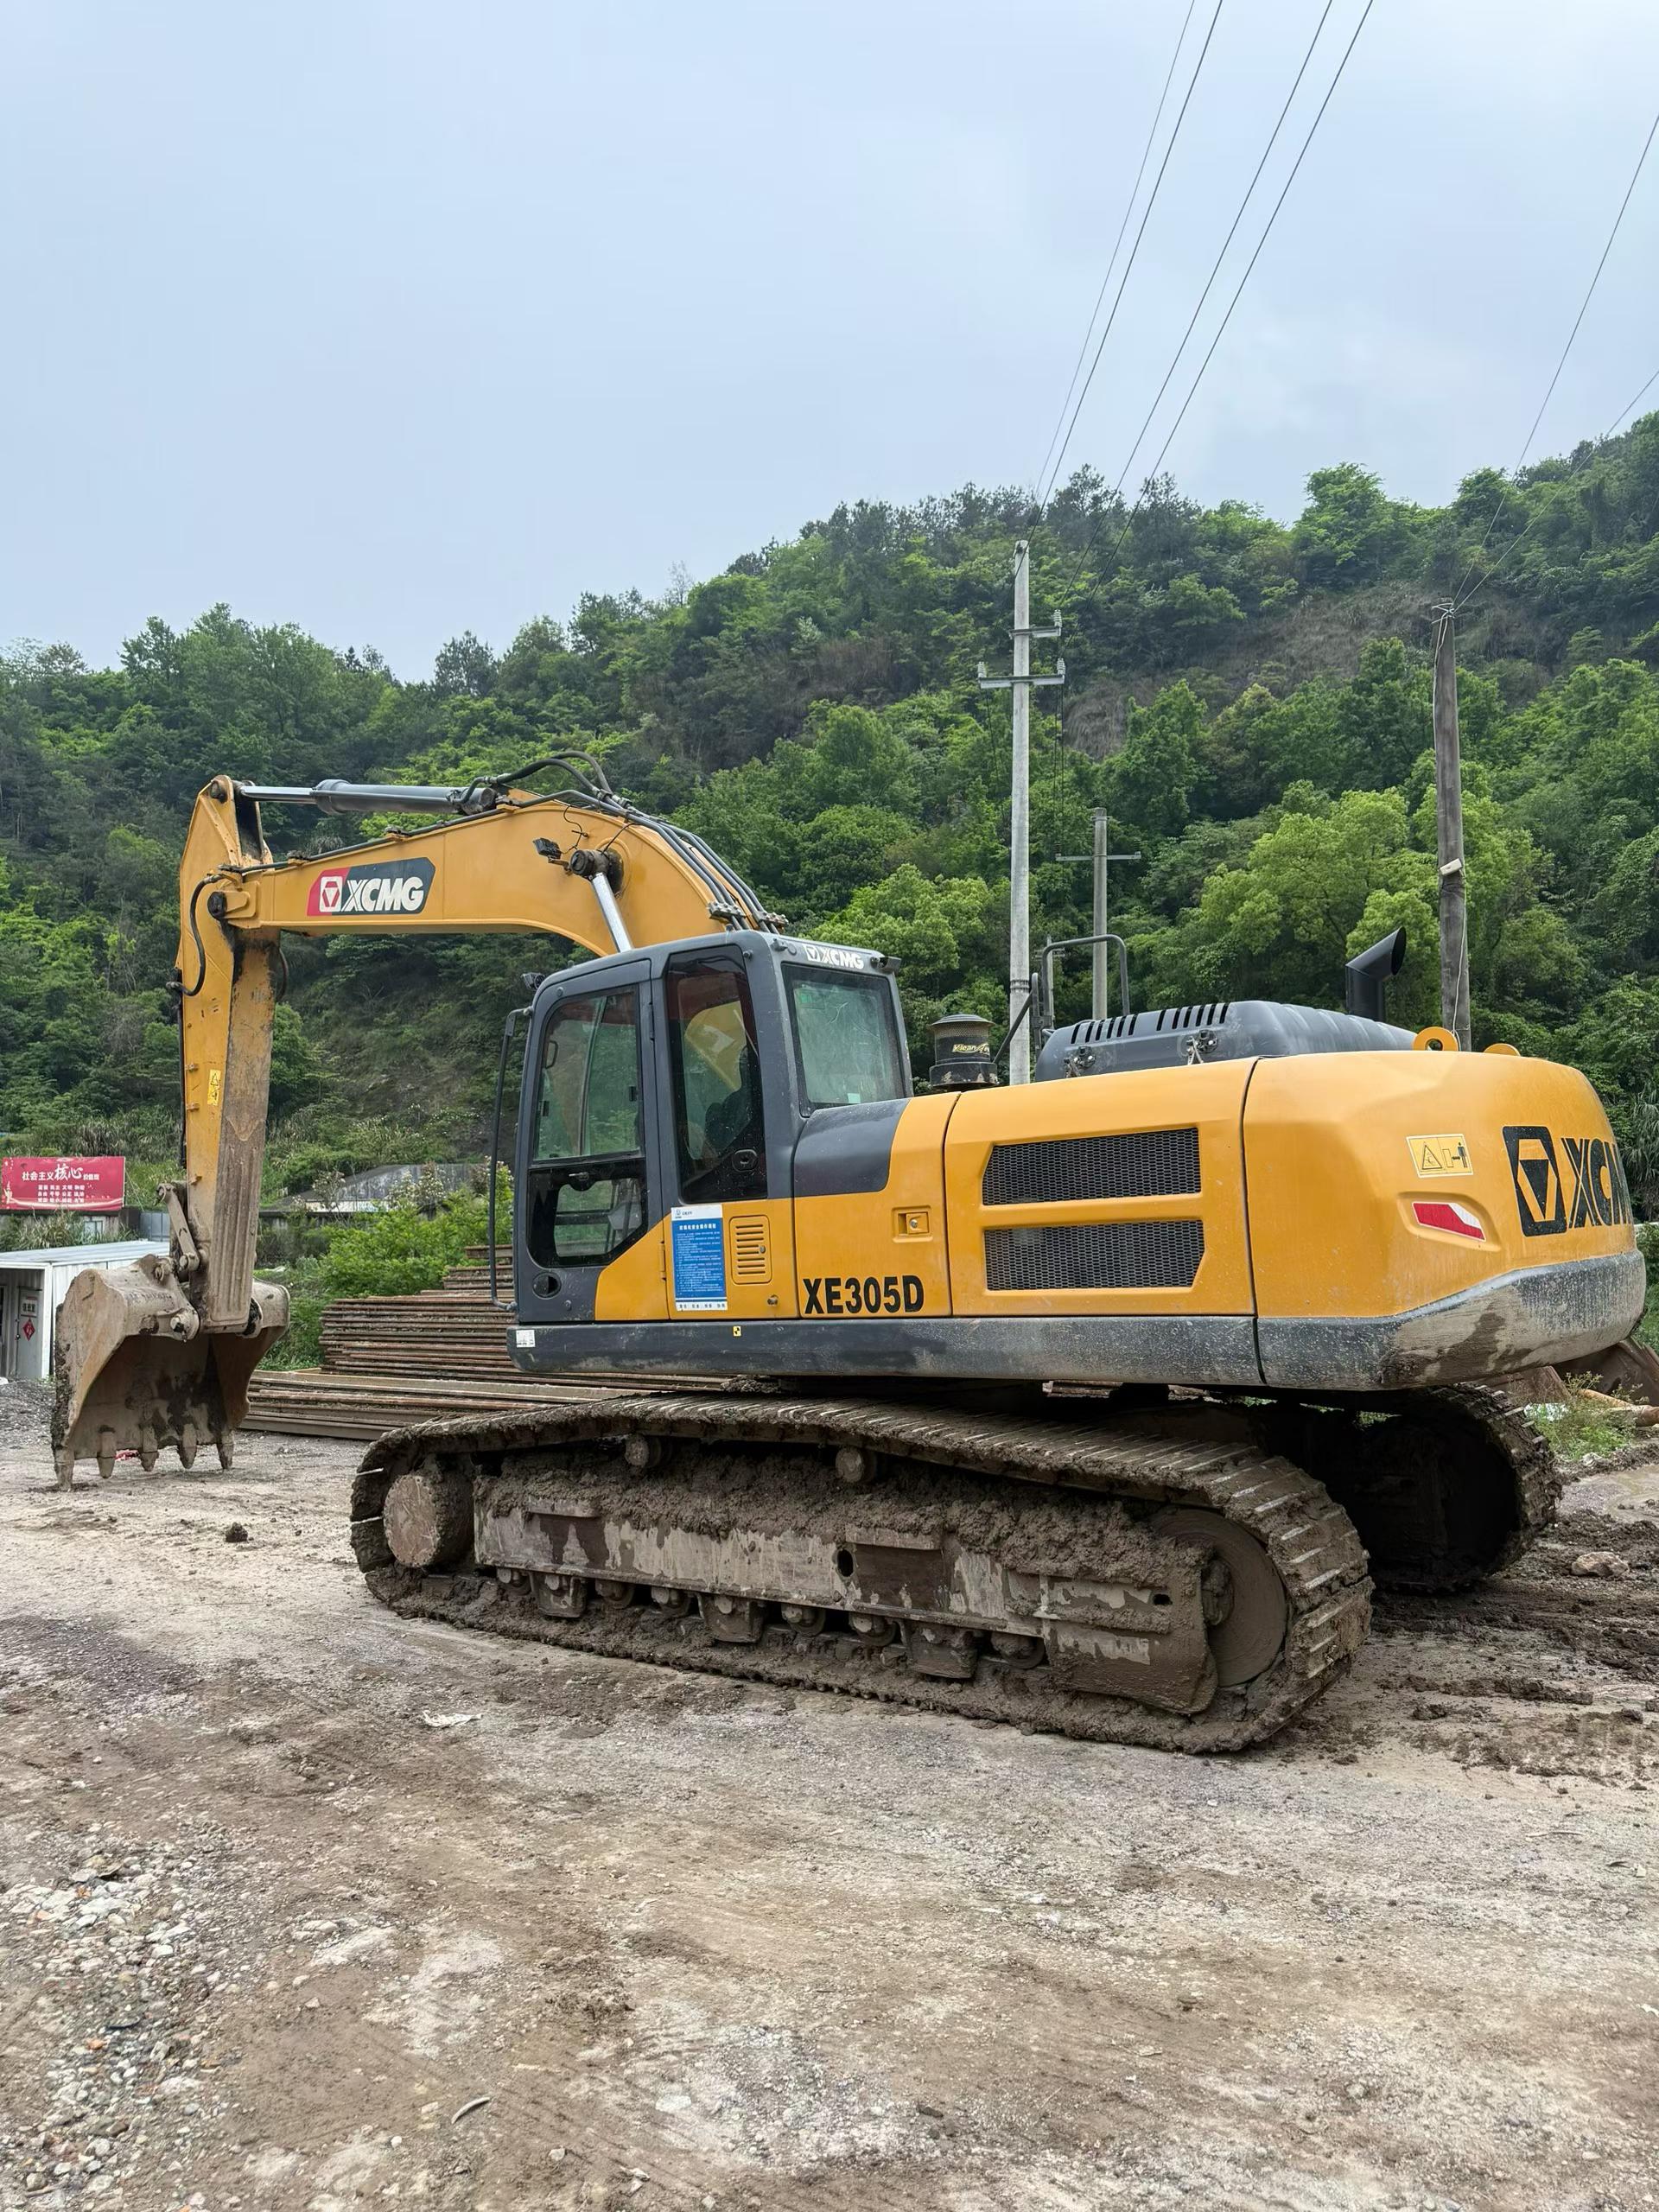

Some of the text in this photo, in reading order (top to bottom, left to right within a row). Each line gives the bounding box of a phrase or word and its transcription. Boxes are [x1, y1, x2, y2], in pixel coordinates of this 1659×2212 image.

[340, 876, 424, 912] XCMG
[817, 946, 864, 969] XCMG
[1560, 1137, 1632, 1228] XCM
[803, 1274, 925, 1314] XE305D
